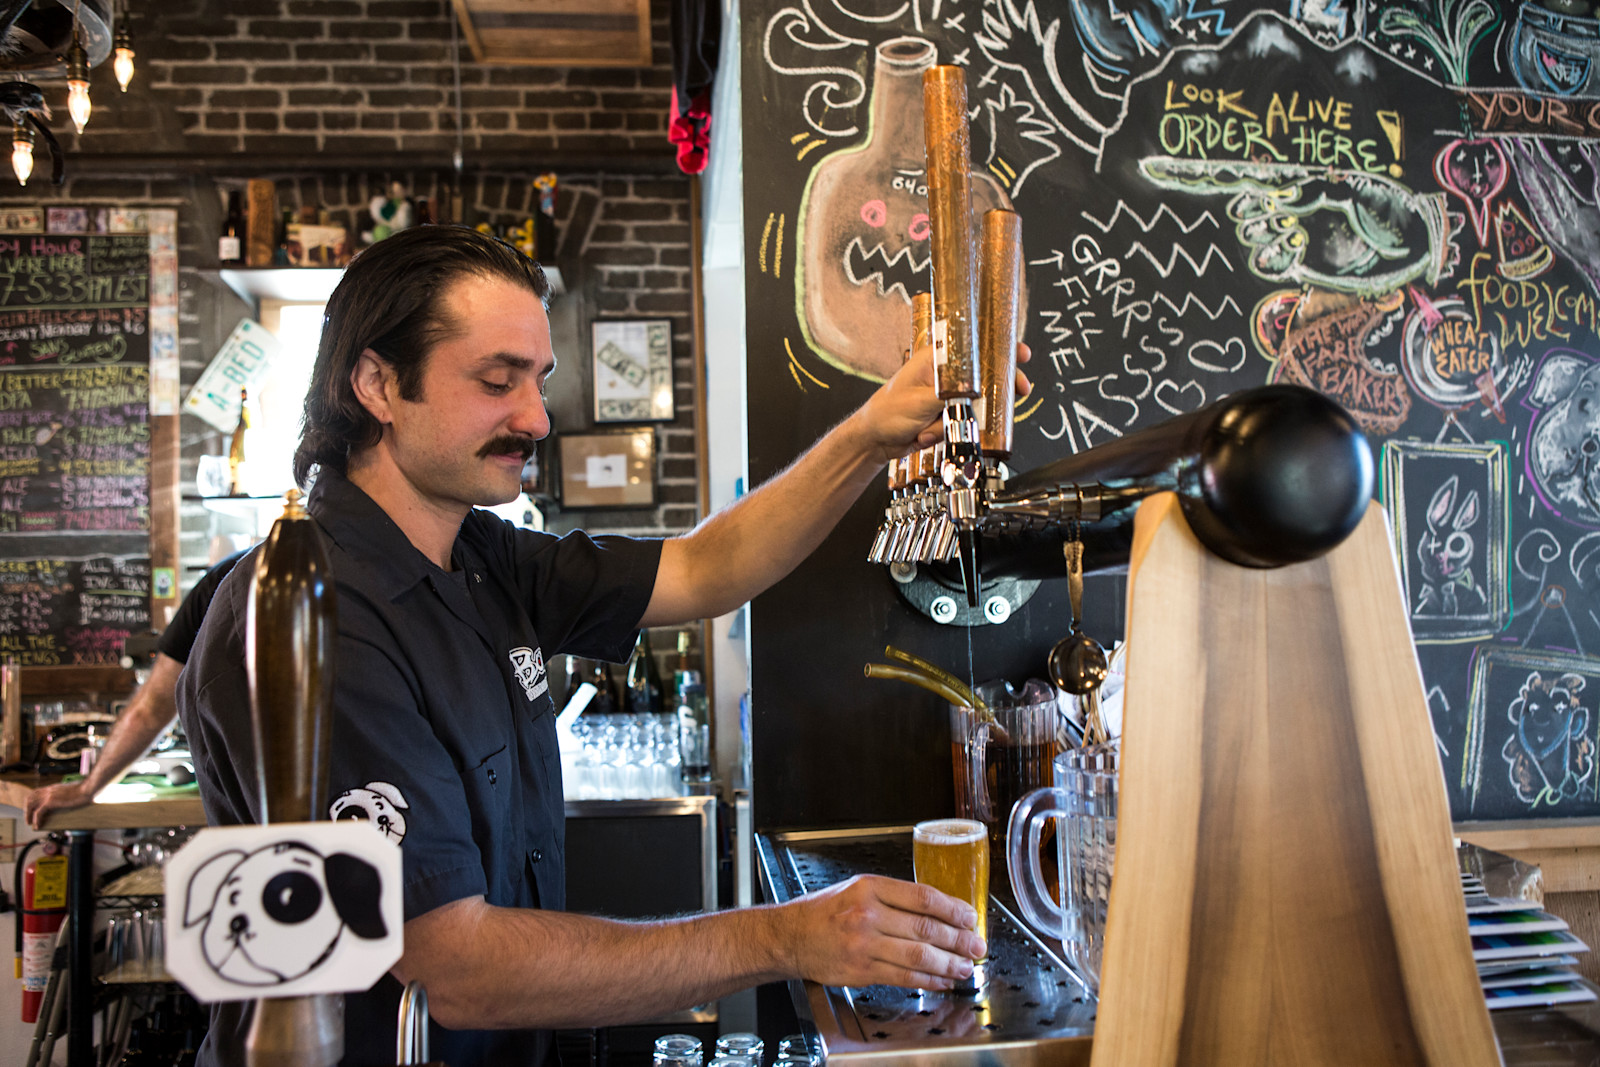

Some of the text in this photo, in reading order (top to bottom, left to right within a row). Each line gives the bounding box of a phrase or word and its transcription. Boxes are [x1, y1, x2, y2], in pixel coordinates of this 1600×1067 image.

[1266, 91, 1353, 139] ALIVE
[1469, 91, 1585, 131] YOUR
[1159, 112, 1289, 162] ORDER
[1430, 321, 1490, 352] WHEAT
[1493, 281, 1600, 355] WELCOM
[1435, 347, 1490, 379] EATER
